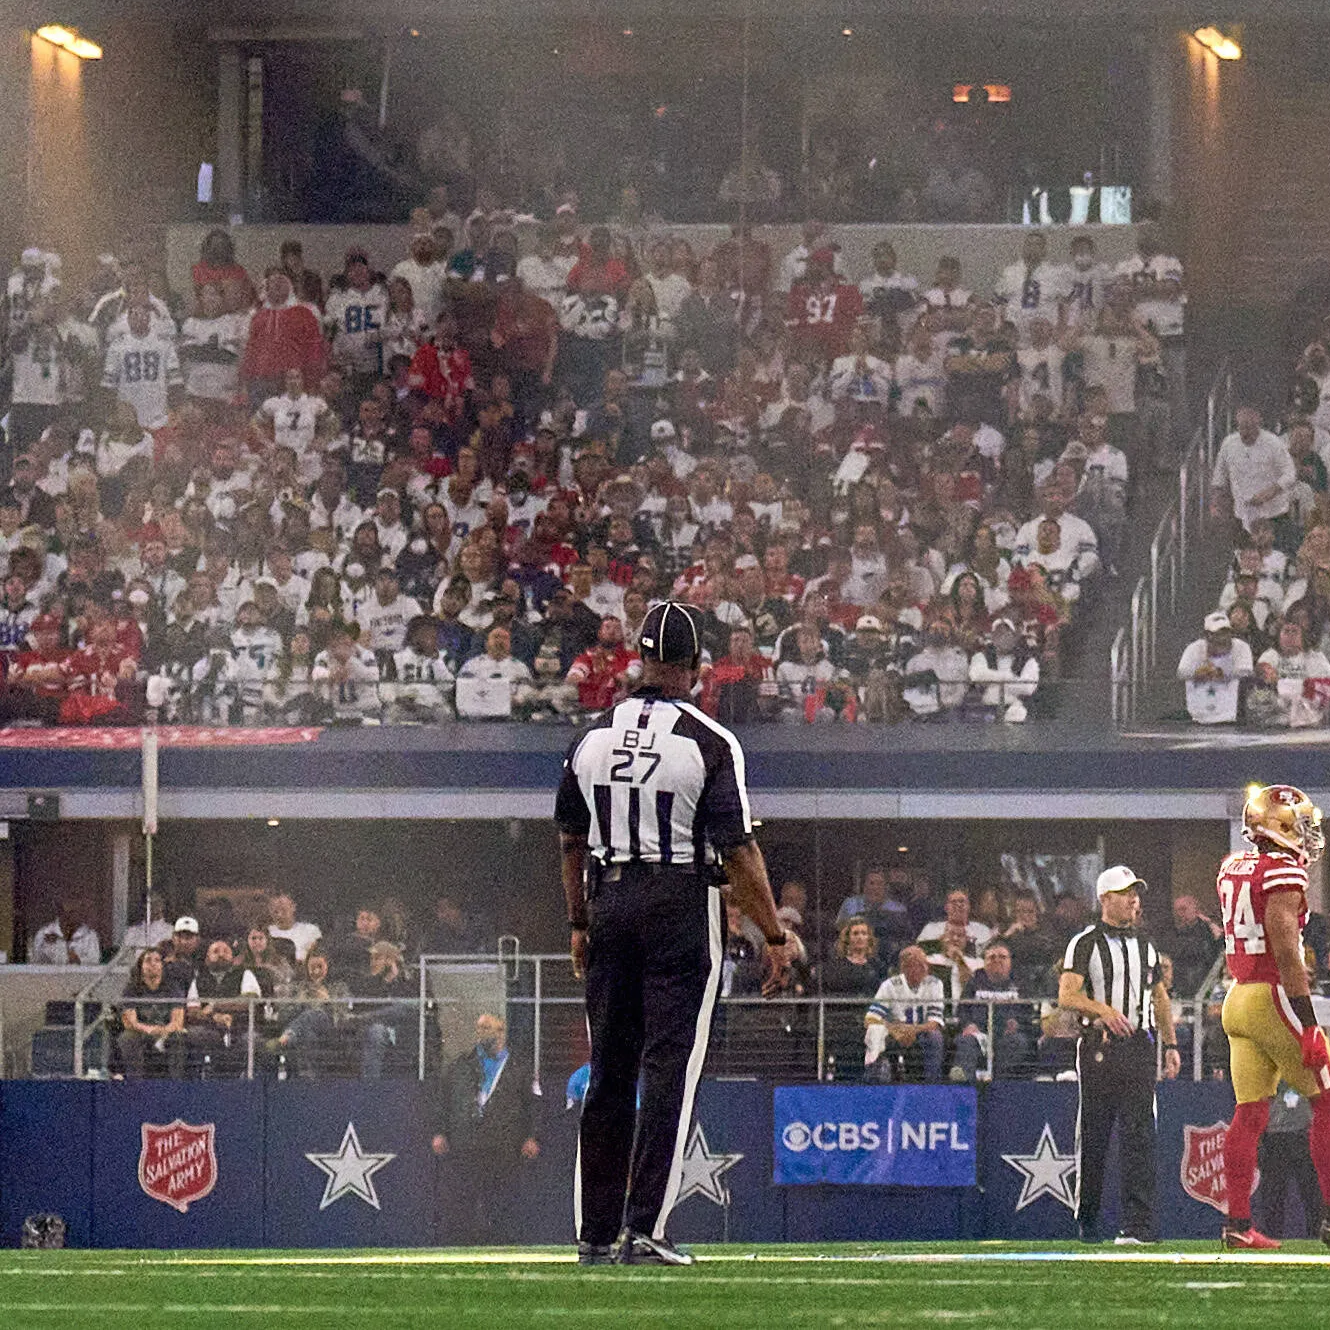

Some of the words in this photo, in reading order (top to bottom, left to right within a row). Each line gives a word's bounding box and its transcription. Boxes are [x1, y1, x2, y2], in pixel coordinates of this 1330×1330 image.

[806, 294, 837, 325] 97
[125, 350, 161, 382] 88
[287, 411, 301, 431] 7
[623, 730, 656, 750] BJ
[611, 749, 662, 784] 27
[154, 1132, 182, 1158] THE
[812, 1122, 881, 1152] CBS
[901, 1121, 970, 1151] NFL
[1199, 1132, 1225, 1159] THE
[146, 1133, 207, 1184] SALVATION
[167, 1157, 205, 1196] ARMY
